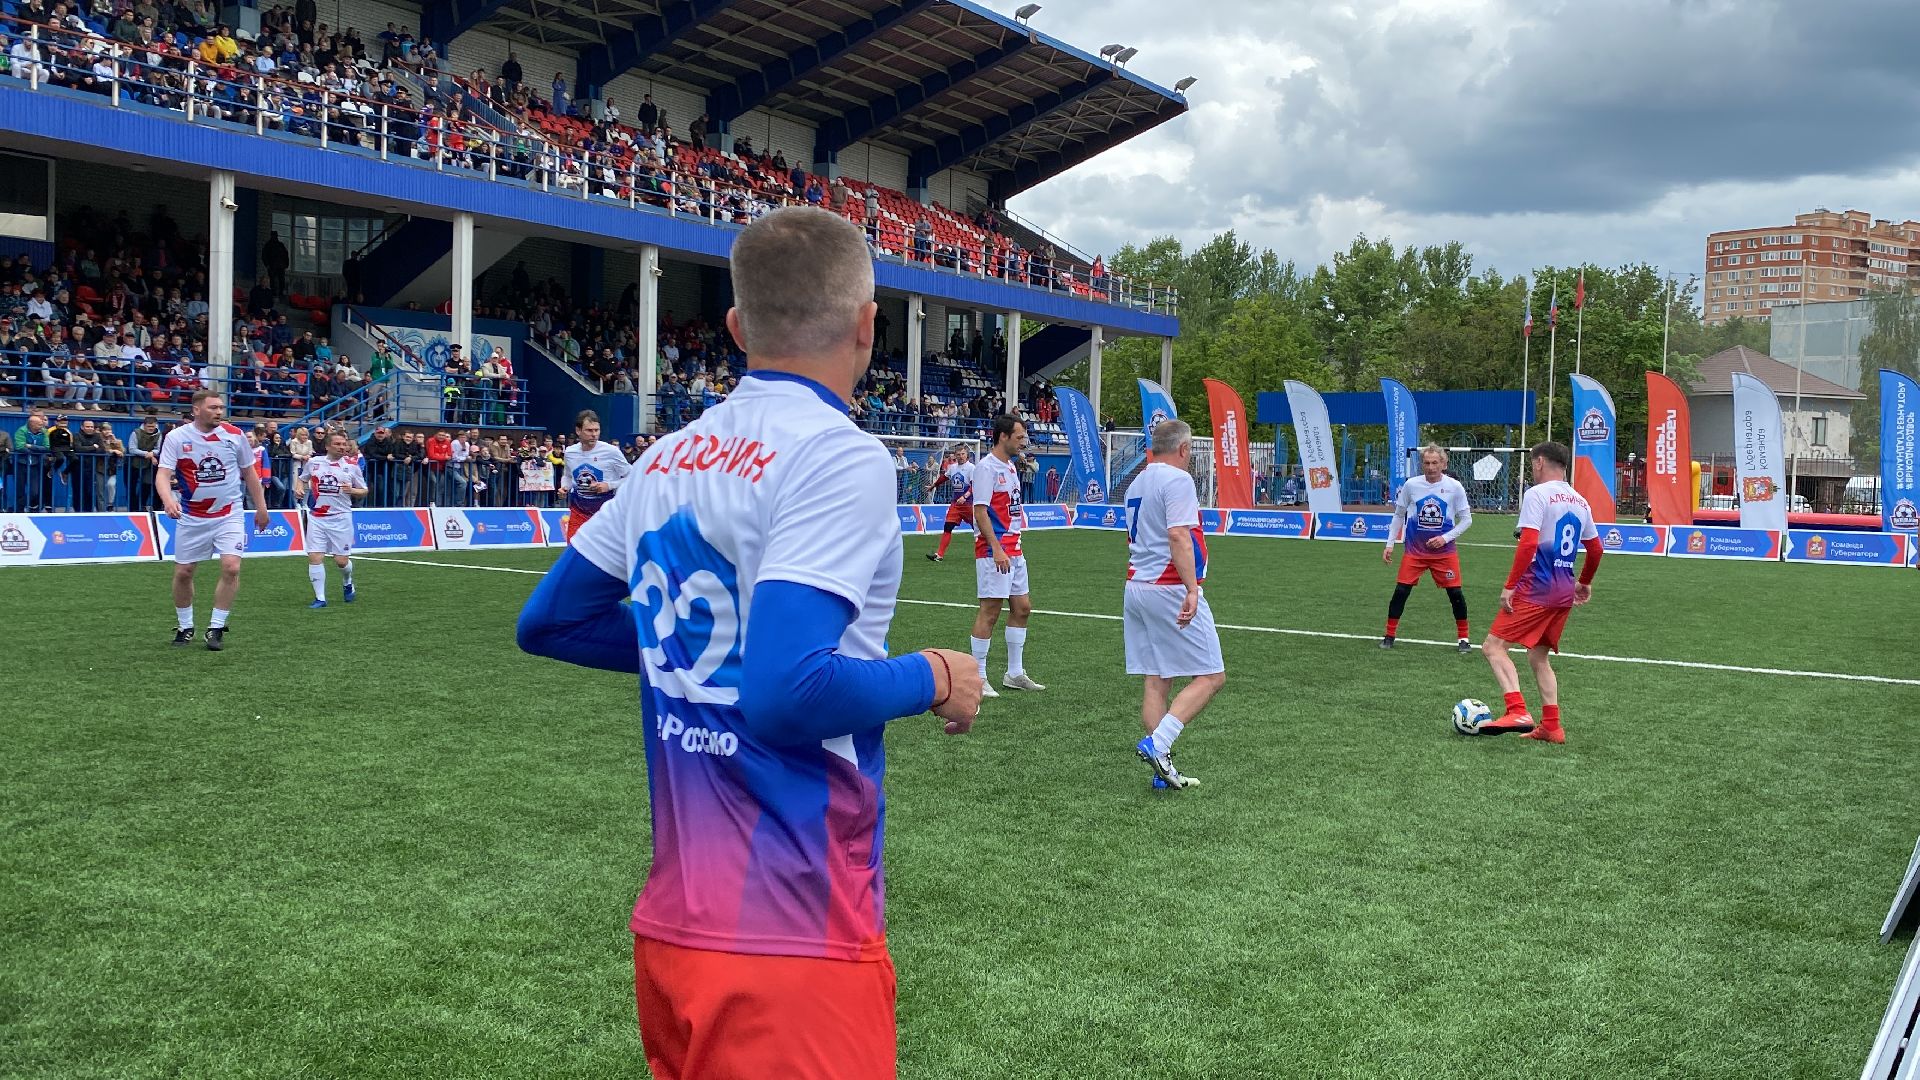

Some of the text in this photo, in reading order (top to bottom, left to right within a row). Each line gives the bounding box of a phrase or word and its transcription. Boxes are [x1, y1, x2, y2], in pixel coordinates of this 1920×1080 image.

[1127, 496, 1143, 543] 7
[357, 522, 392, 531] Команда
[1560, 523, 1575, 557] 8
[1710, 536, 1742, 544] Команда
[1709, 544, 1755, 553] Губернатора
[1831, 541, 1864, 550] Команда
[1830, 550, 1879, 559] Губернатора
[631, 560, 739, 706] 22
